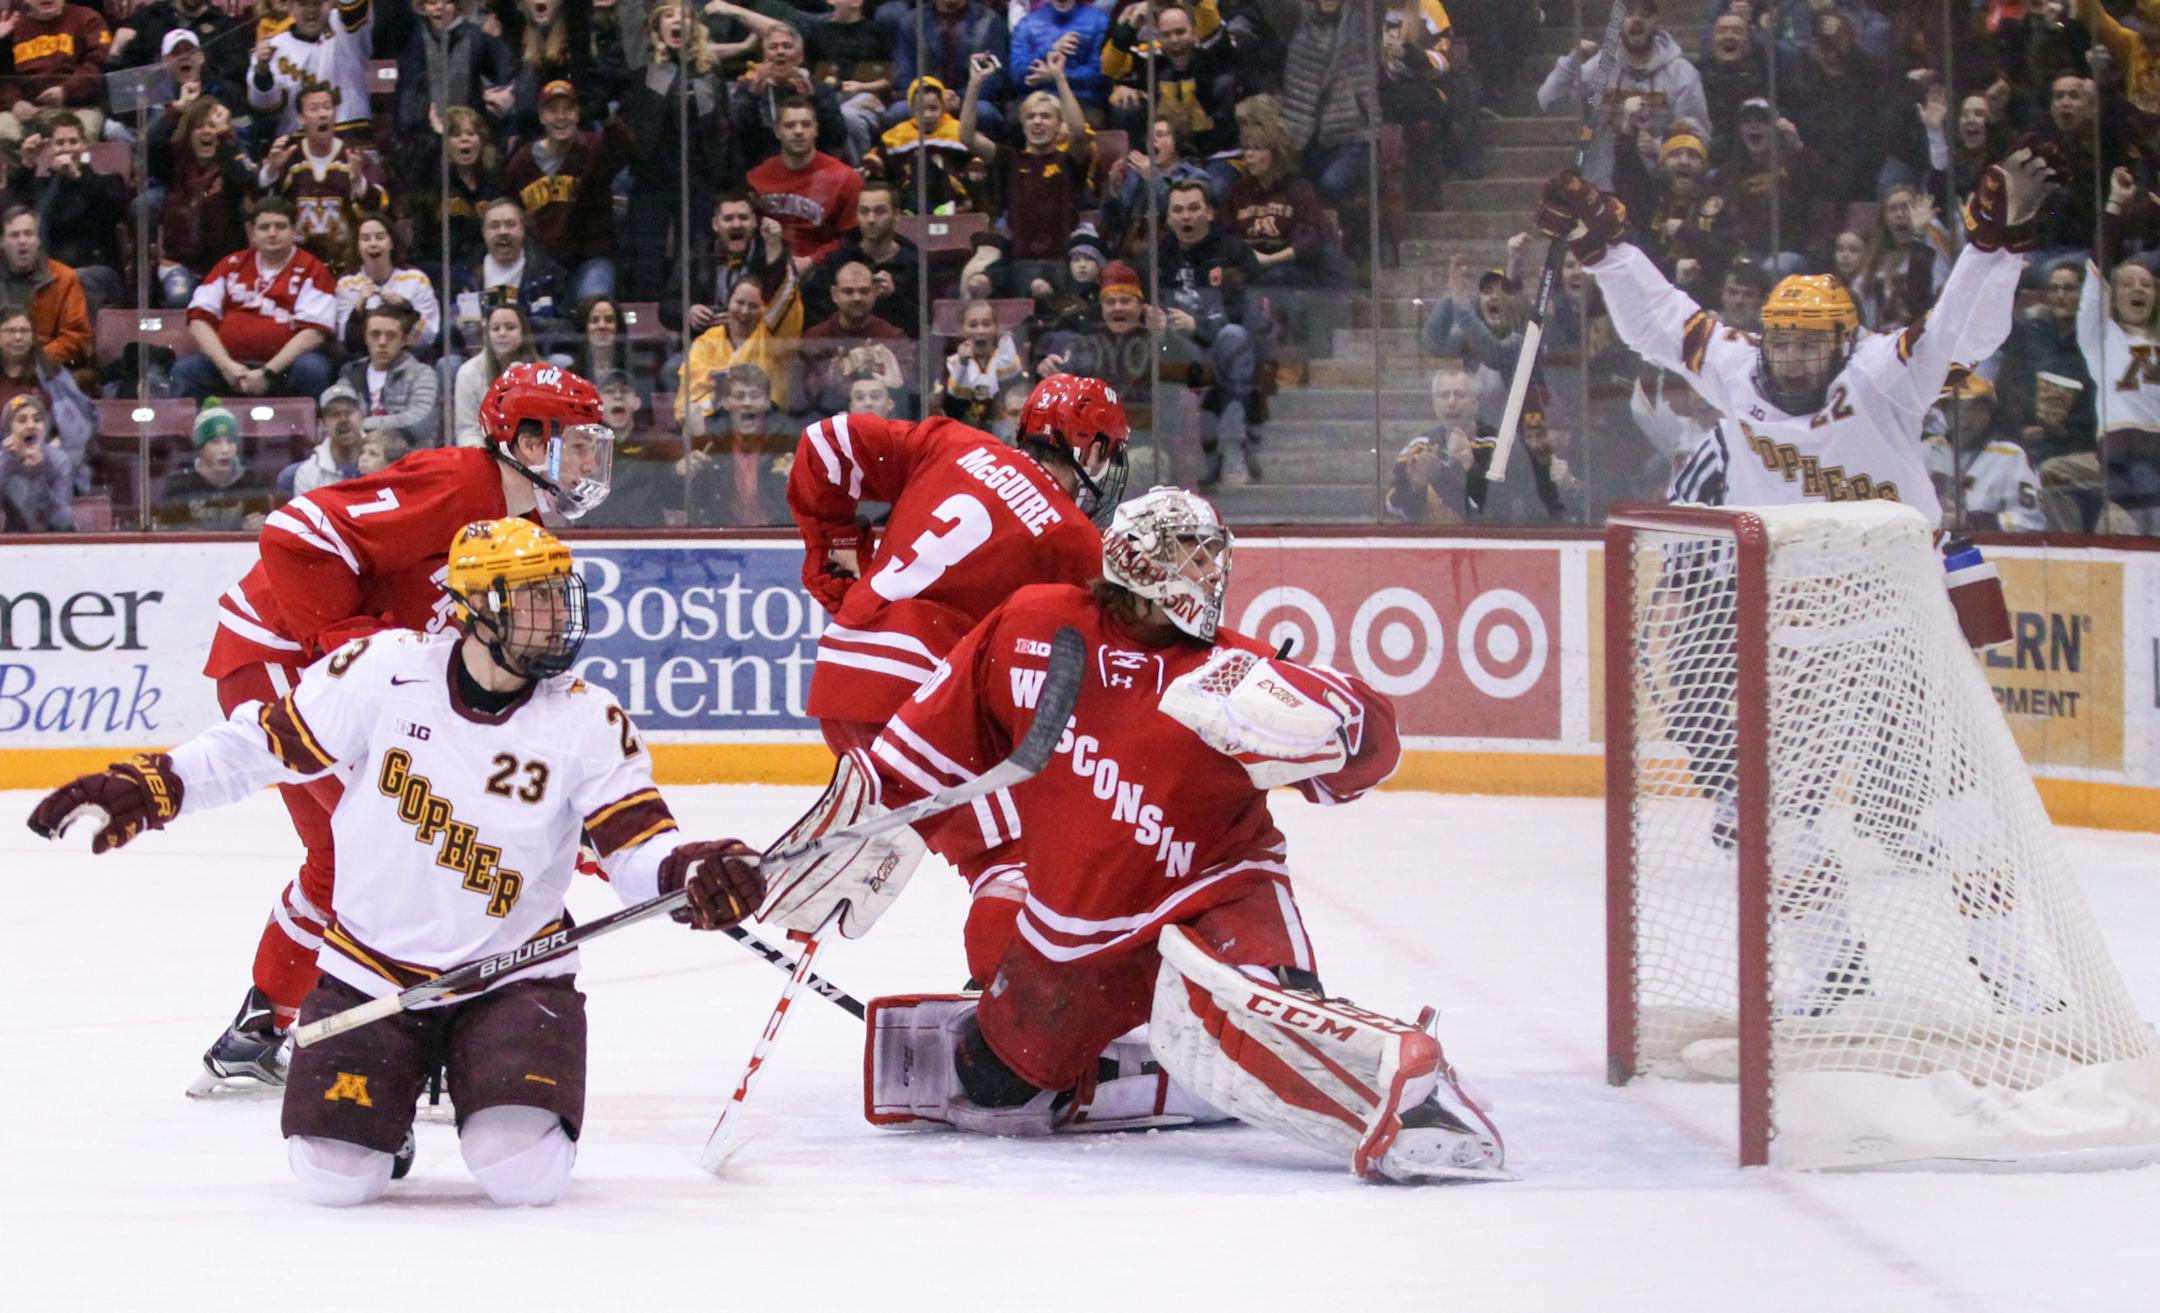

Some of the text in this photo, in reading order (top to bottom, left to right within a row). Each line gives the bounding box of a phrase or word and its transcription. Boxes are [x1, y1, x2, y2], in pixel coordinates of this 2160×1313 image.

[536, 369, 562, 385] W
[346, 487, 400, 519] 7
[956, 447, 1062, 537] McGUIRE
[870, 493, 993, 602] 3
[0, 664, 162, 732] Bank
[485, 753, 551, 804] 23
[1010, 667, 1195, 878] WSCONSIN
[378, 747, 524, 918] GOPHER
[1246, 993, 1358, 1043] CCM
